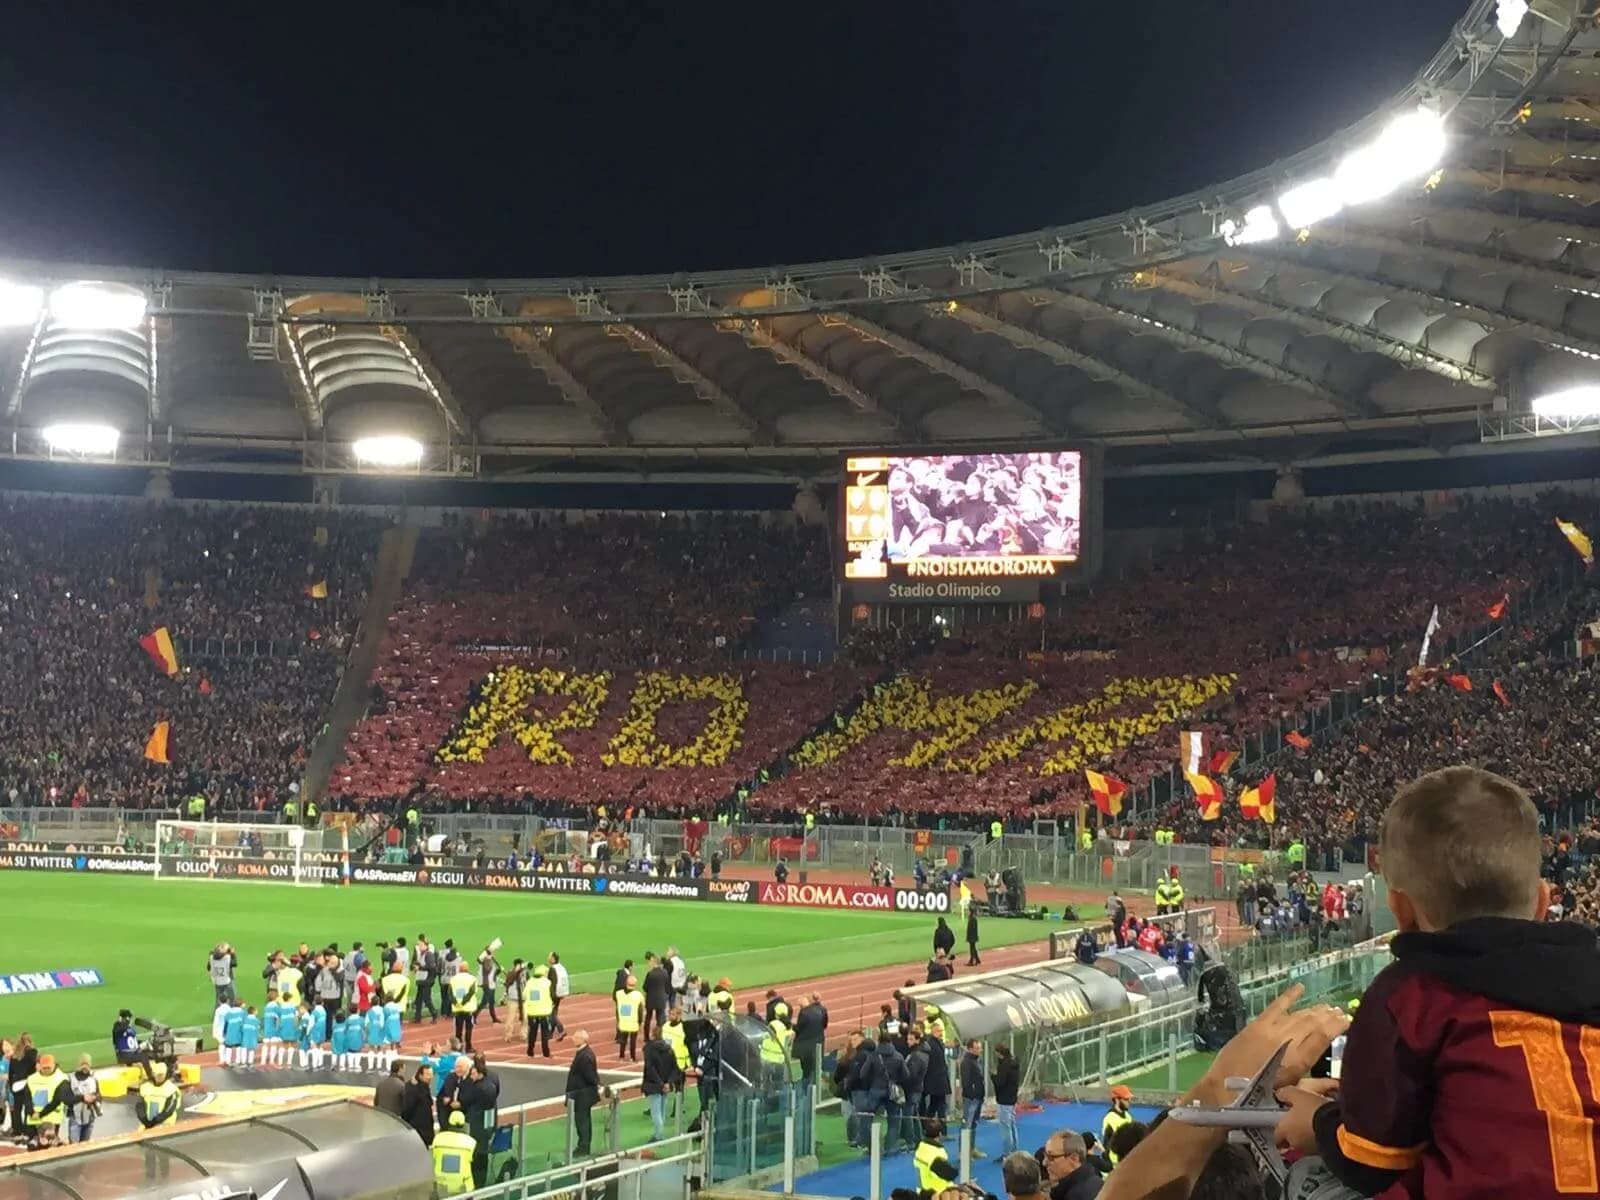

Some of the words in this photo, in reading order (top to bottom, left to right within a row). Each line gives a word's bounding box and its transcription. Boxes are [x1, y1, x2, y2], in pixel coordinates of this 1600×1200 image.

[907, 558, 1056, 576] #NOISIAMOROMA
[889, 582, 934, 598] Stadio
[936, 581, 1001, 600] Olimpico
[14, 856, 27, 867] SU
[29, 856, 74, 869] TWITTER
[87, 858, 163, 872] @OfficialASRoma
[237, 865, 269, 875] ROMA
[270, 865, 288, 876] ON
[291, 866, 339, 878] TWITTER
[354, 868, 416, 883] @ASRomaEN
[430, 872, 464, 885] SEGUI
[485, 875, 519, 888] ROMA
[520, 876, 535, 889] SU
[538, 877, 592, 892] TWITTER
[609, 880, 699, 897] @OfficialASRoma
[763, 883, 890, 908] ASROMA.COM
[896, 890, 948, 912] 00:00
[1041, 990, 1089, 1022] ROMA
